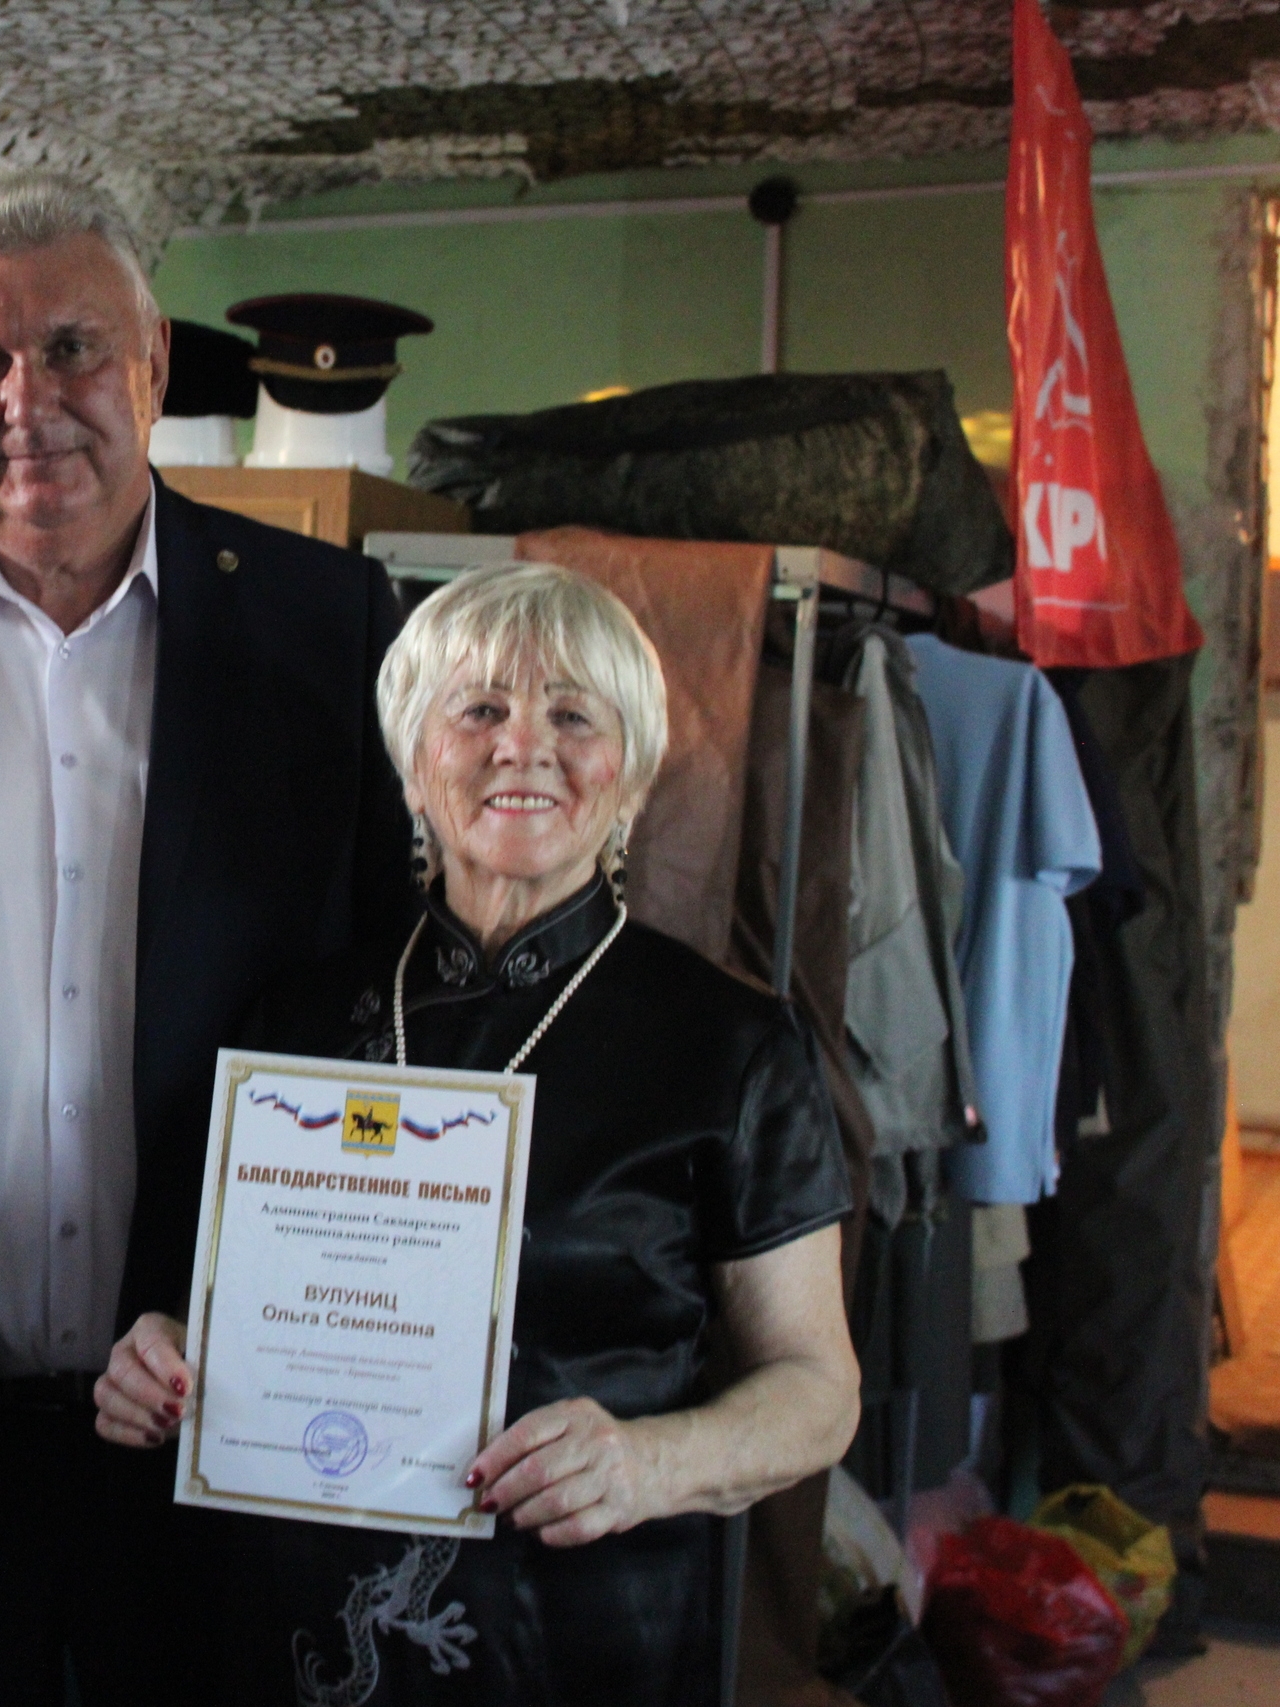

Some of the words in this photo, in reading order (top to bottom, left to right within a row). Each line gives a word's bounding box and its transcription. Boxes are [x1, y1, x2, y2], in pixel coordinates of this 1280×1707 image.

[237, 1164, 411, 1199] БЛАГОДАРСТВЕННОЕ
[417, 1182, 492, 1205] ПИСЬМО
[373, 1213, 461, 1233] Сакмарского
[274, 1225, 390, 1245] муниципального
[392, 1233, 442, 1250] района
[304, 1284, 398, 1312] ВУЛУНИЦ
[261, 1304, 320, 1328] Ольга
[326, 1311, 436, 1339] Семеновна
